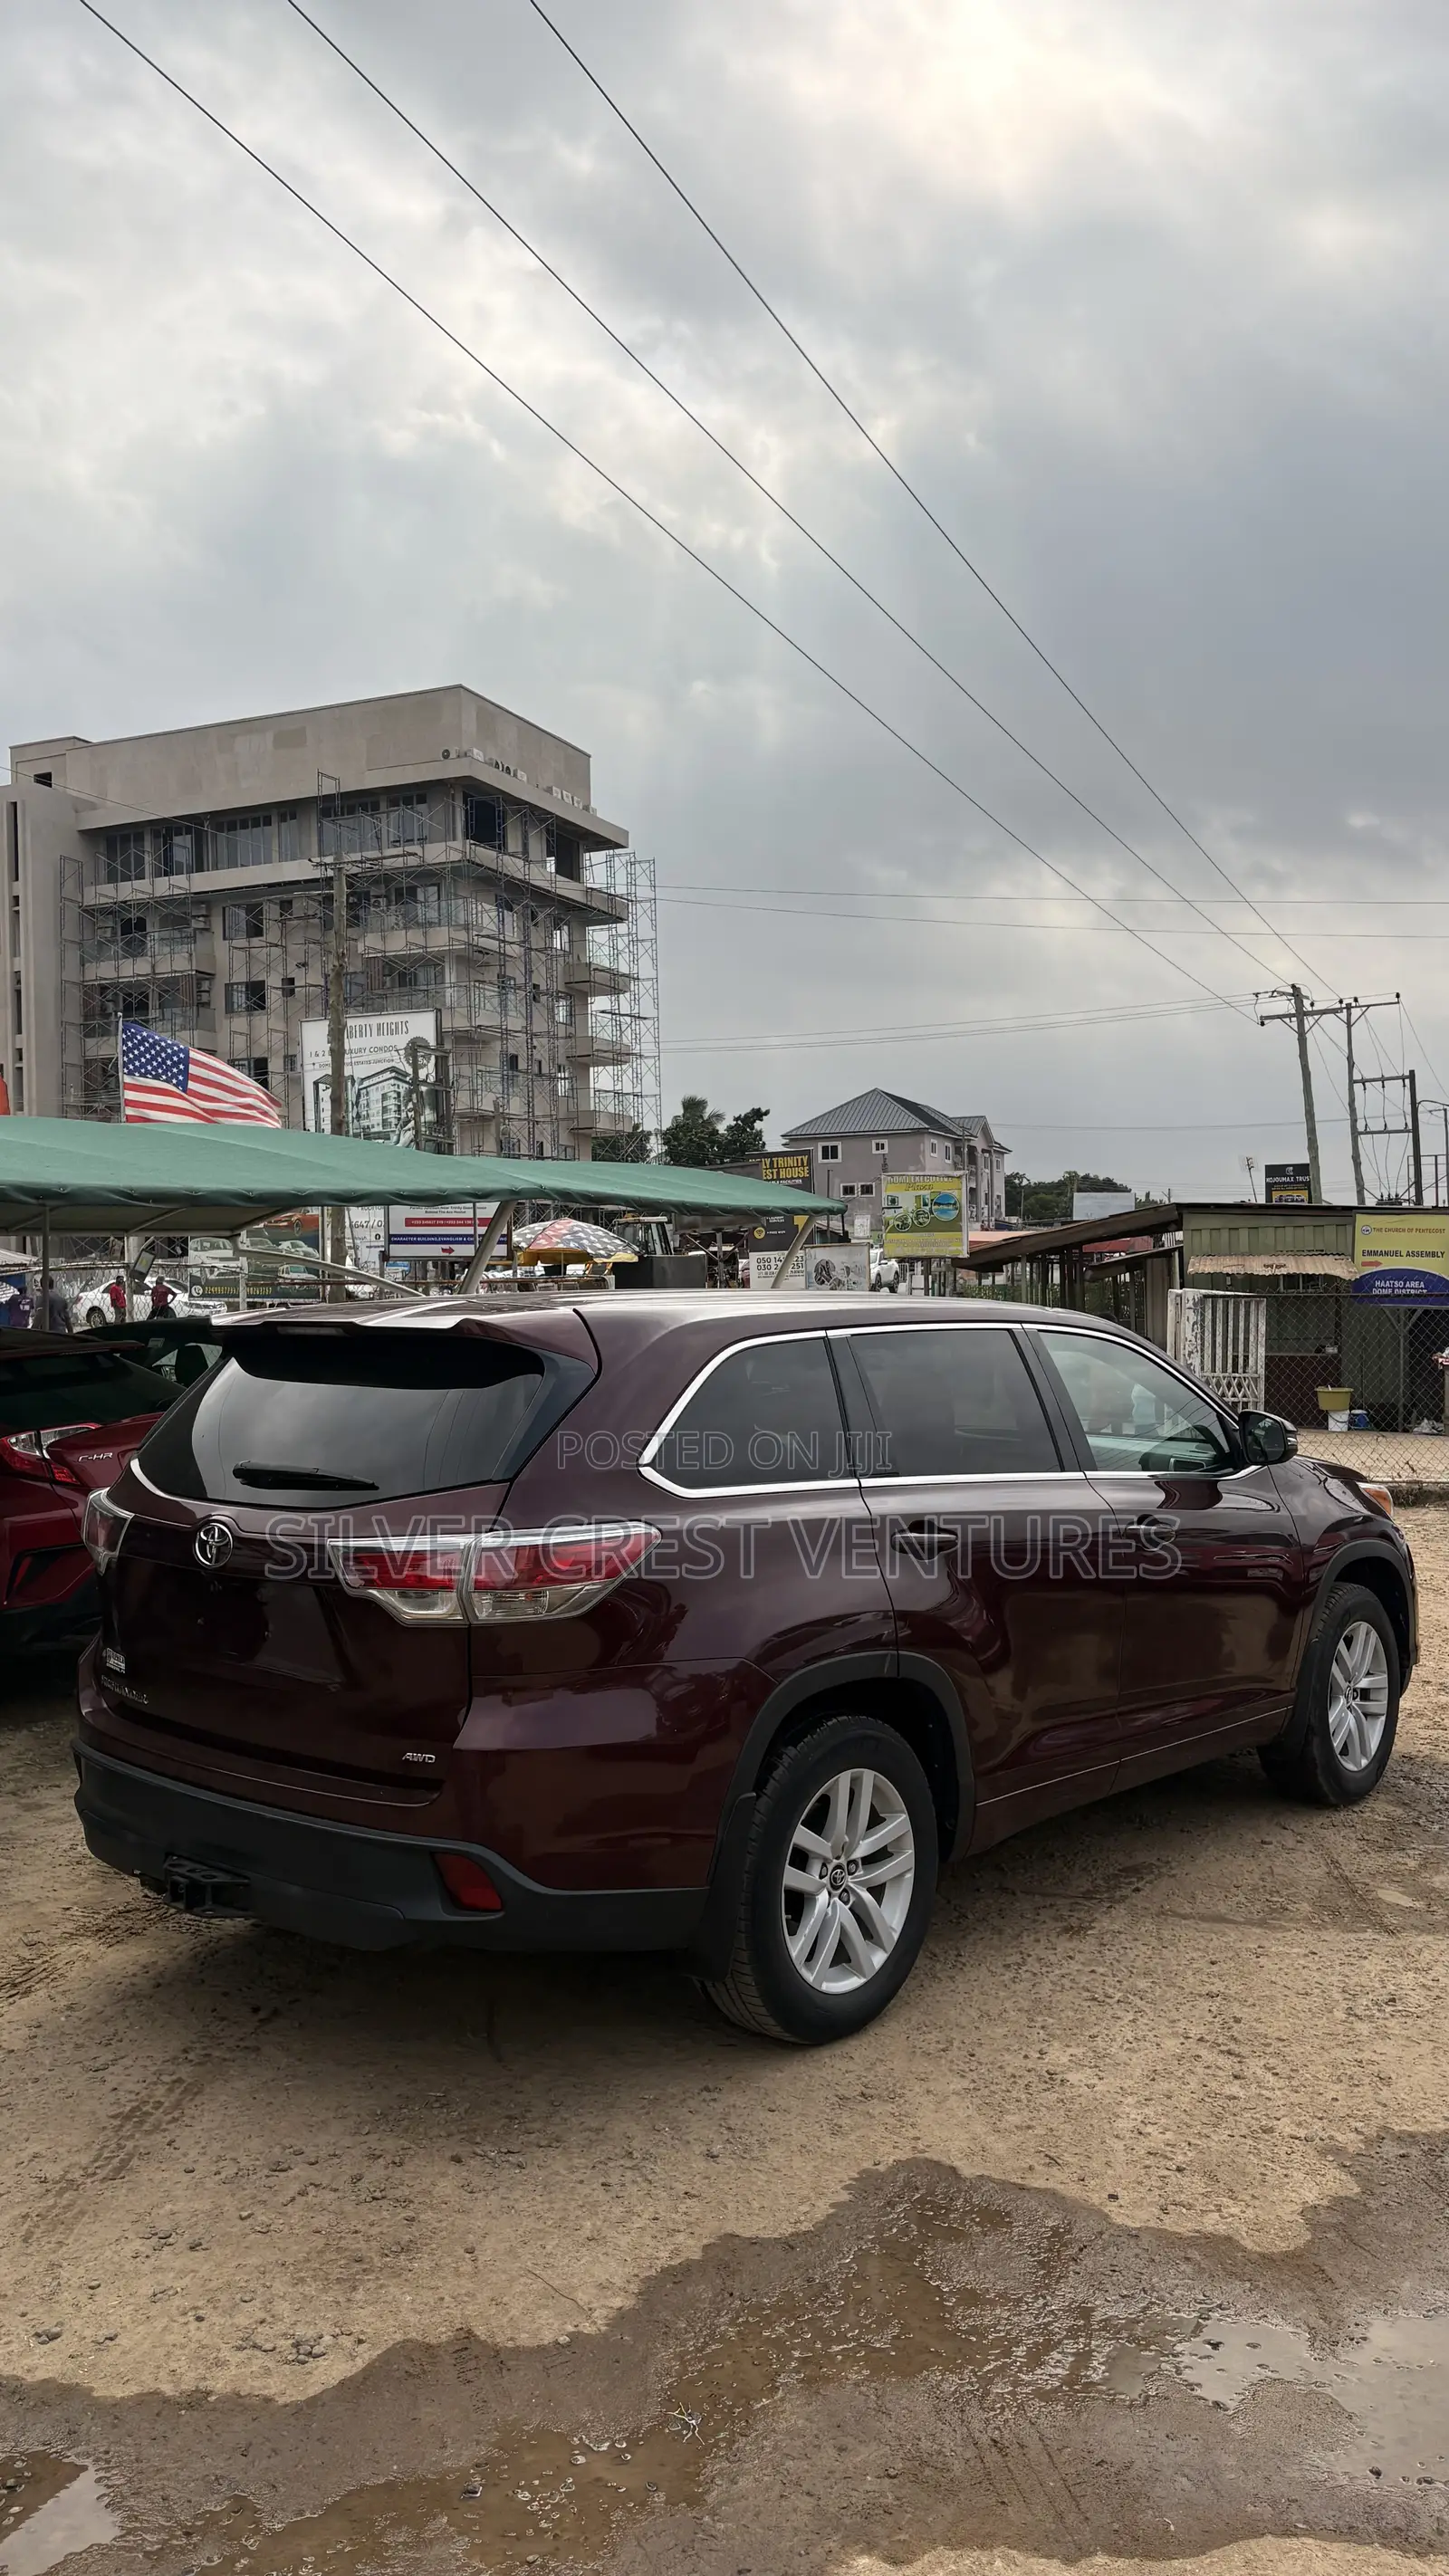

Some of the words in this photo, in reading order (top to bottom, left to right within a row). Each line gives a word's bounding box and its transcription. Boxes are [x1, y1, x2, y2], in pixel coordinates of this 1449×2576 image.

[376, 1020, 409, 1037] HEIGHTS
[344, 1047, 367, 1055] UXURY
[369, 1044, 398, 1053] CONDOS
[772, 1155, 809, 1169] TRINITY
[779, 1166, 810, 1179] HOUSE
[1362, 1250, 1404, 1258] EMMANUEL
[1406, 1280, 1425, 1288] AREA
[78, 1452, 113, 1462] C-HR
[401, 1752, 436, 1763] AWD
